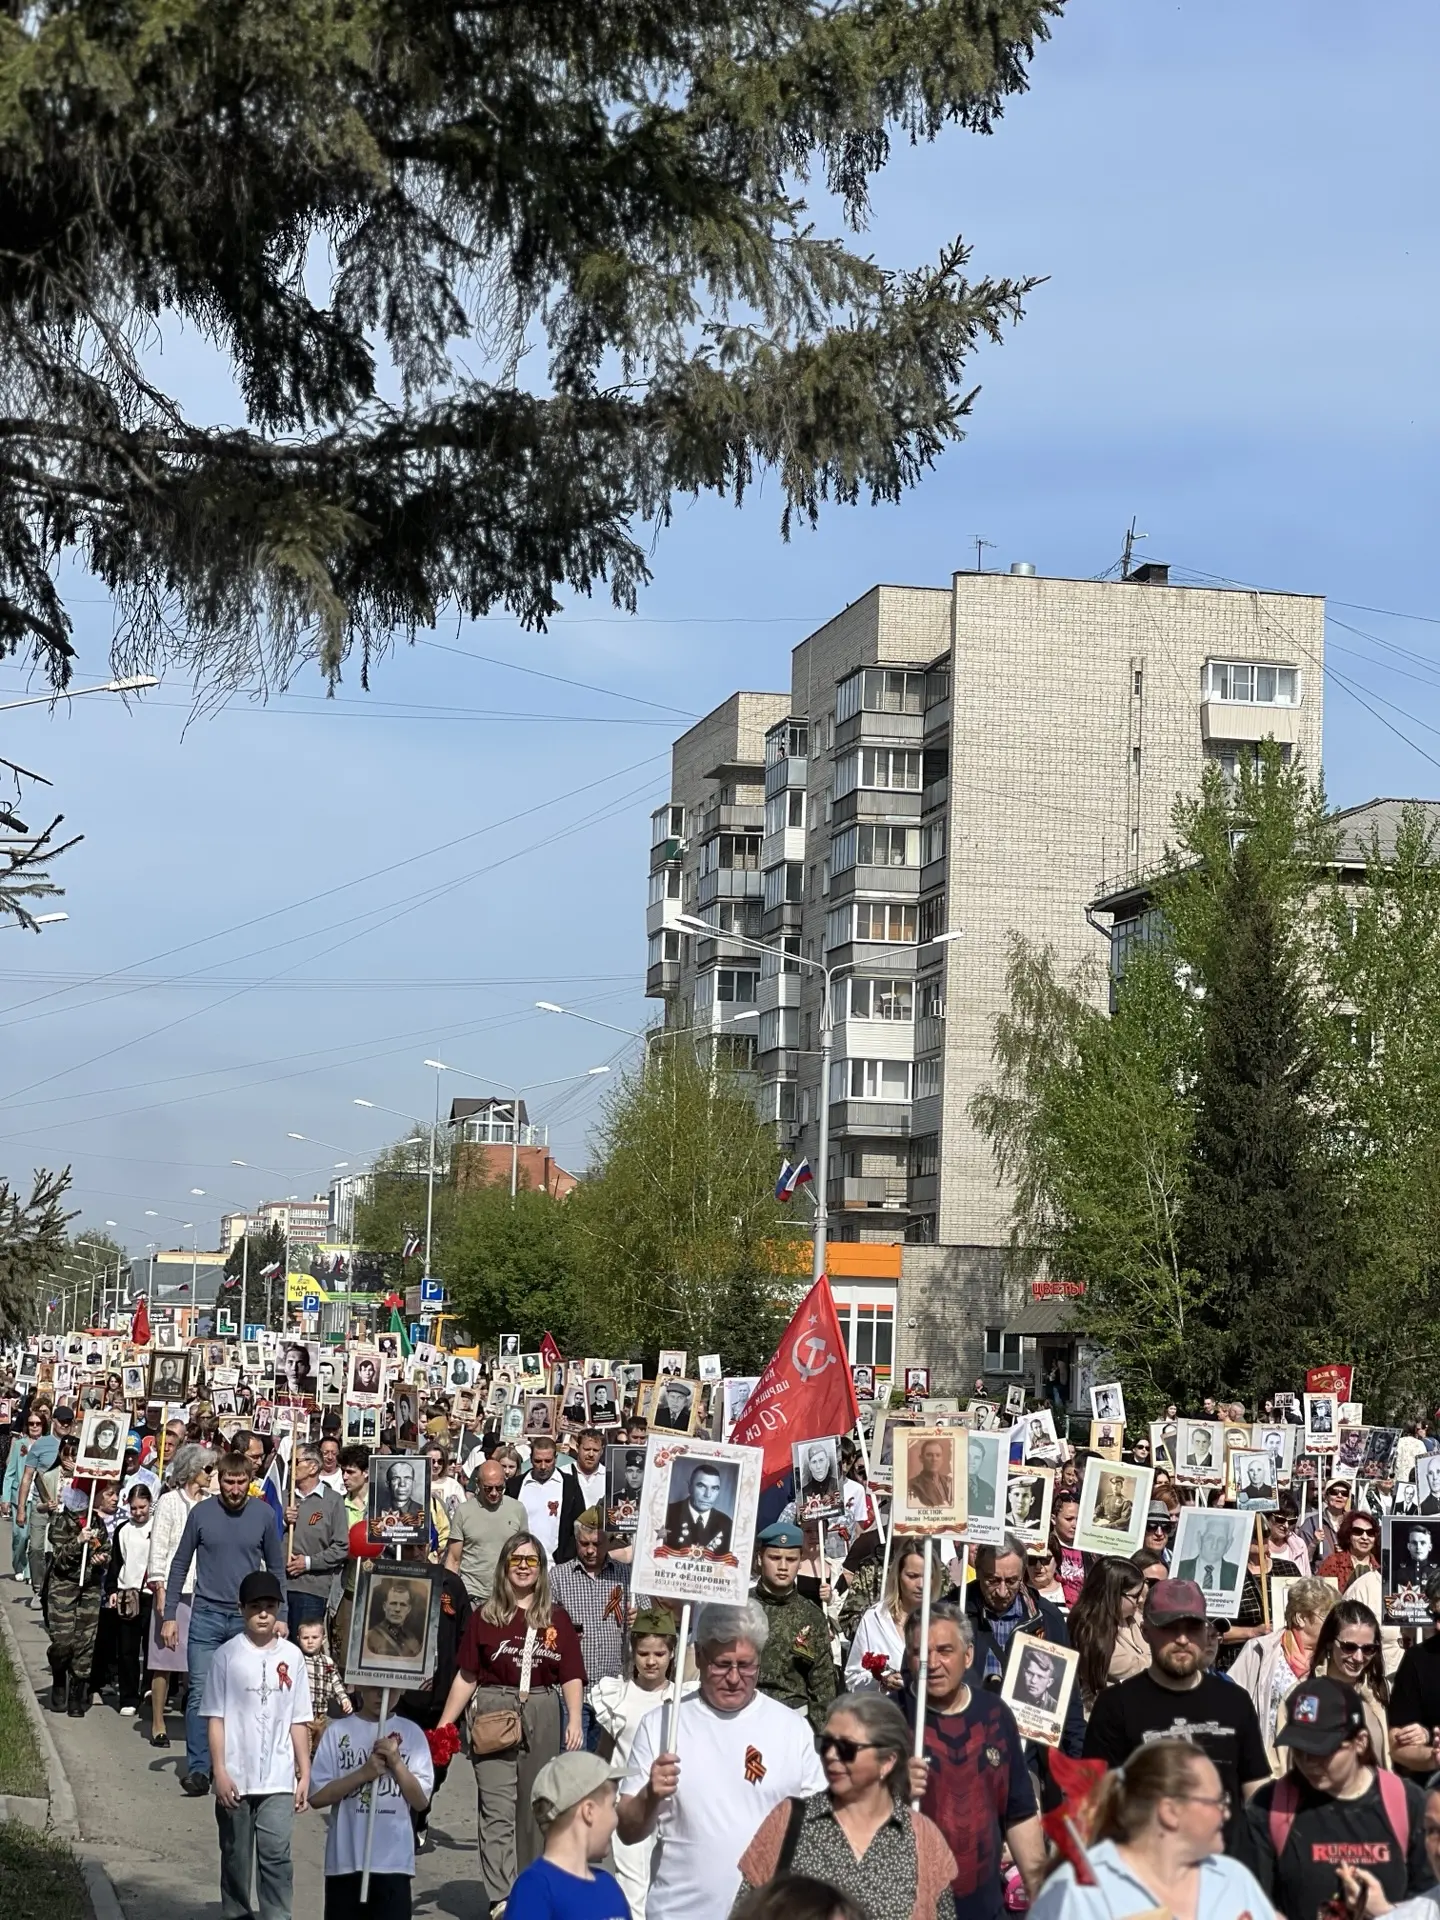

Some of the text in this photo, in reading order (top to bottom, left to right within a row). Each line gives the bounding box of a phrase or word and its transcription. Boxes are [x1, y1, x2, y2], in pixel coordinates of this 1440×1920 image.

[1032, 1281, 1085, 1297] ЦВЕТЫ
[675, 1562, 713, 1573] САРАЕВ
[654, 1569, 731, 1586] ПЁТР ФЁДОРОВИЧ
[373, 1672, 394, 1680] СЕРГЕЙ
[1312, 1842, 1391, 1862] RUNNING
